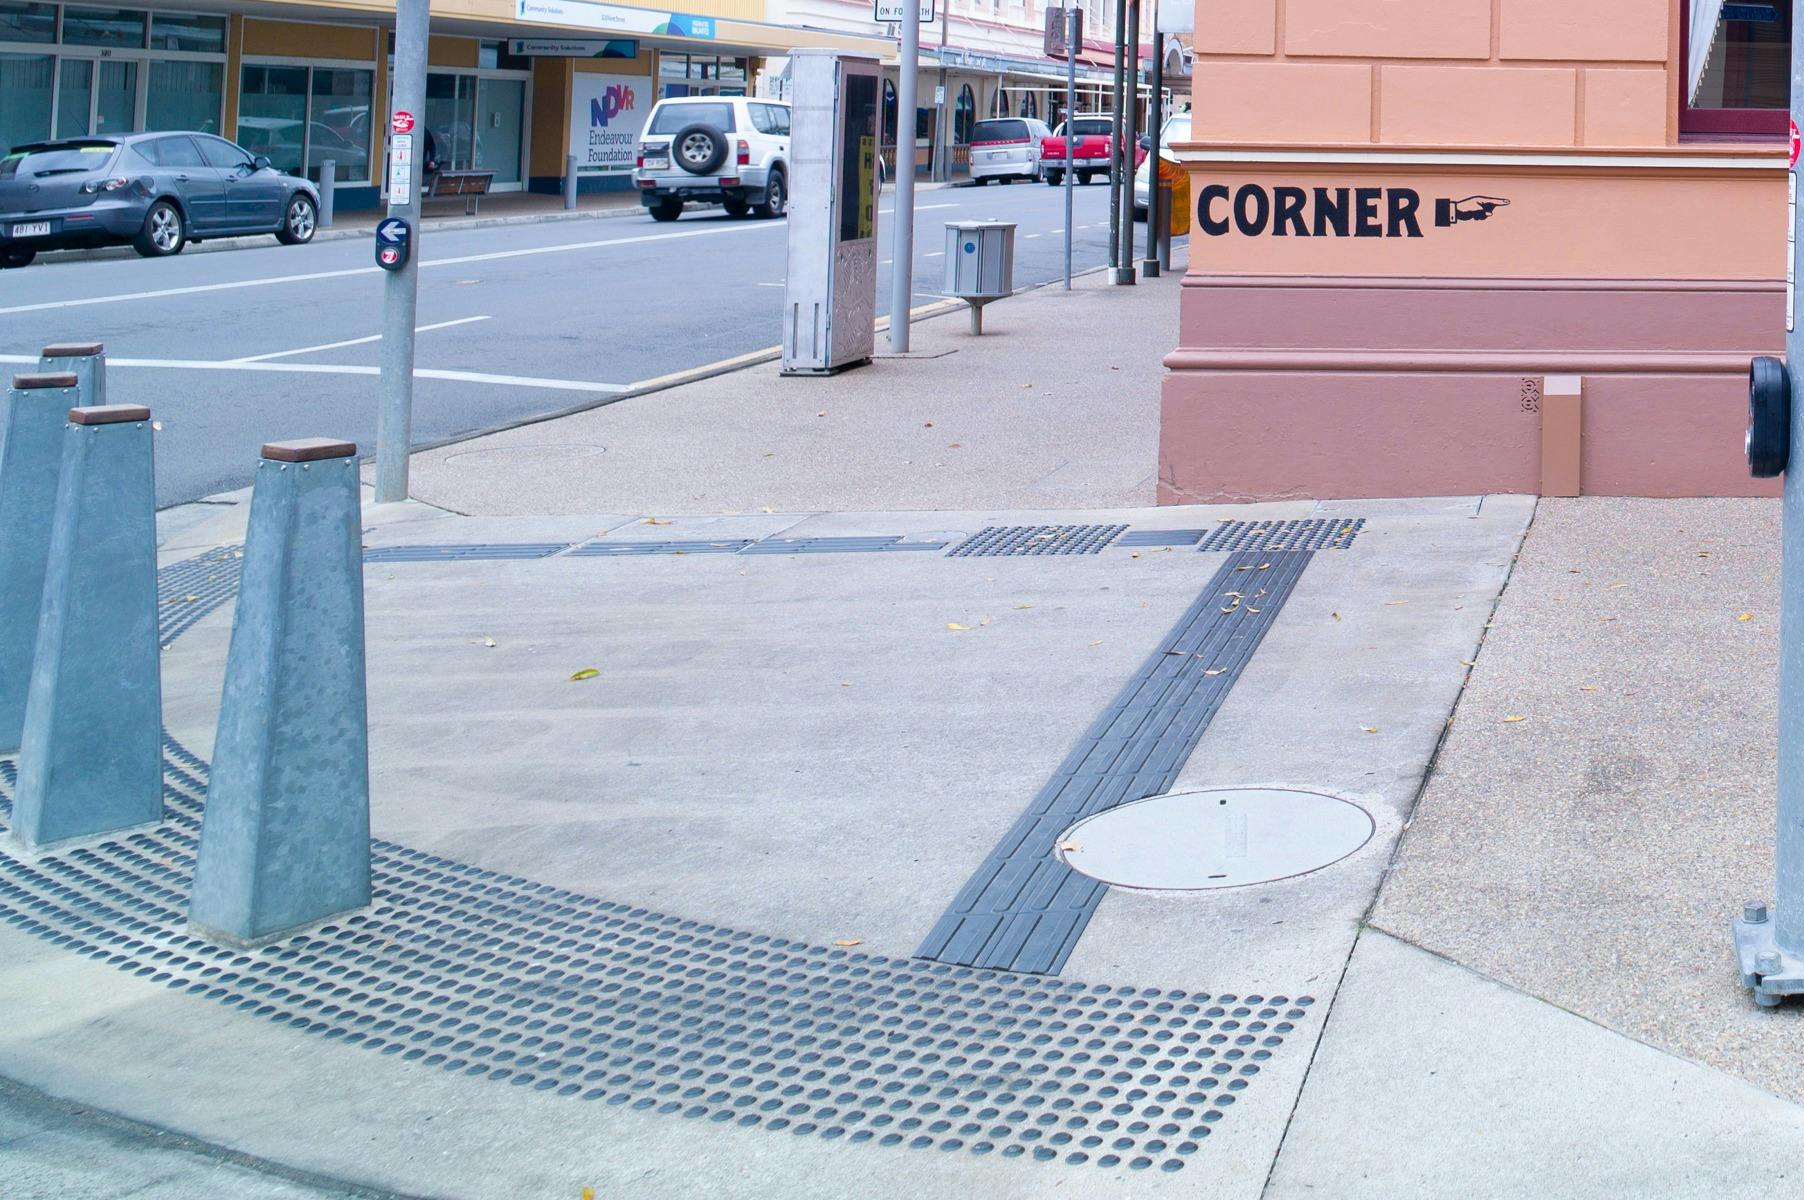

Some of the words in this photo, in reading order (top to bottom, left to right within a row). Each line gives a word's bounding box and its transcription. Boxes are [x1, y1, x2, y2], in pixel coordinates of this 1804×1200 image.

[880, 7, 890, 16] ON
[894, 7, 930, 16] FOTH
[590, 84, 635, 127] NDVR
[589, 130, 633, 145] Endeavour
[588, 148, 633, 162] Foundation
[1197, 183, 1425, 238] CORNER
